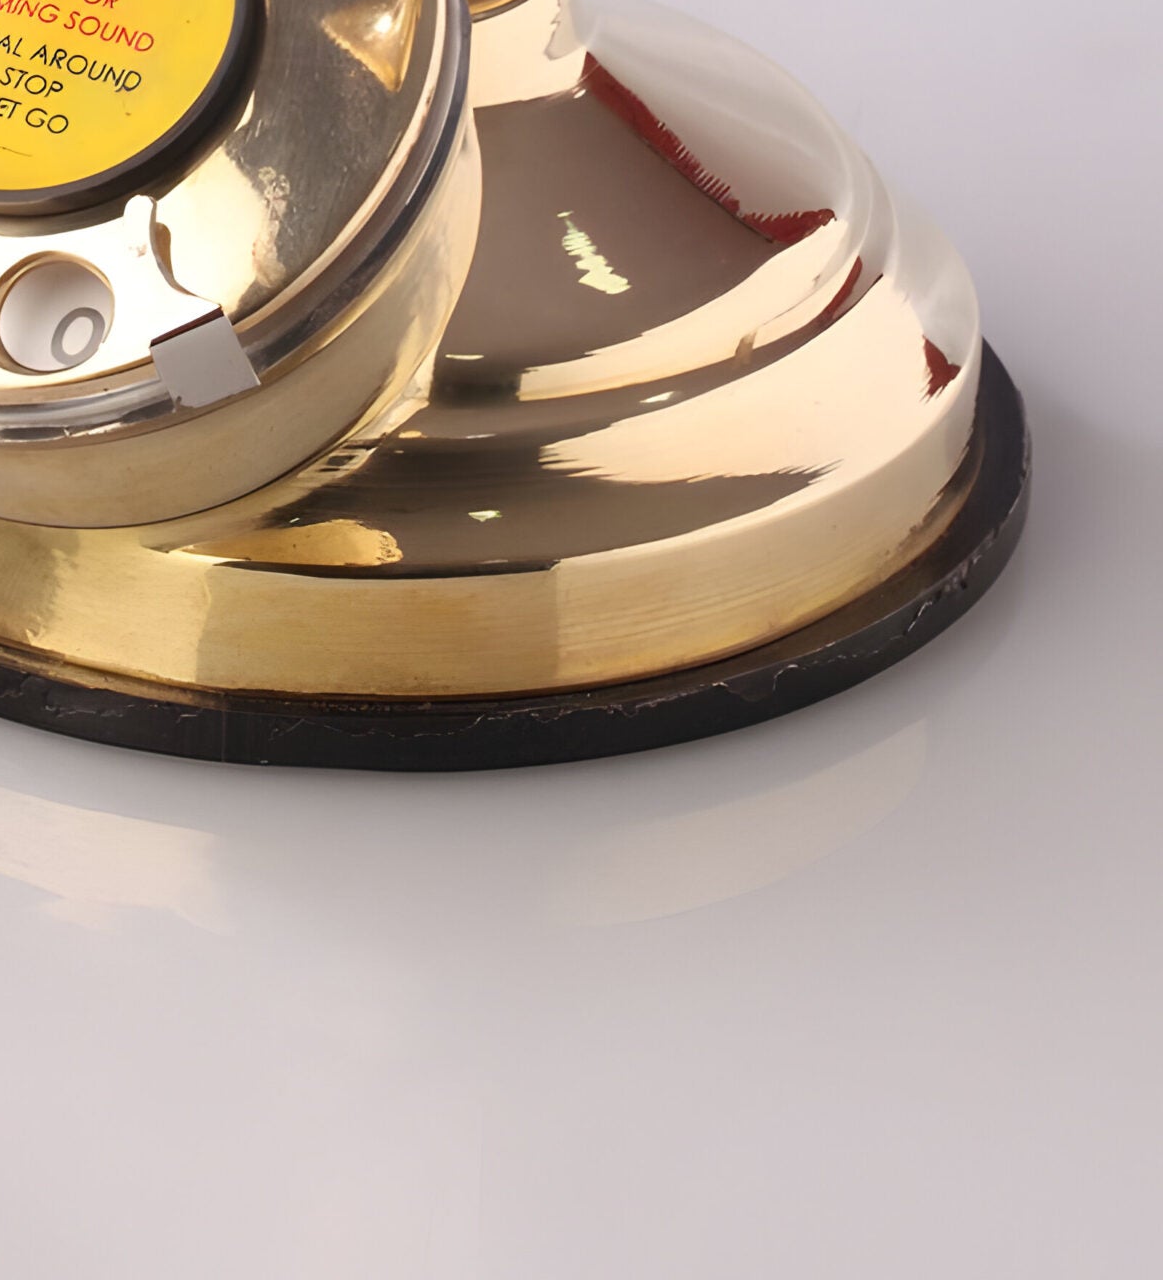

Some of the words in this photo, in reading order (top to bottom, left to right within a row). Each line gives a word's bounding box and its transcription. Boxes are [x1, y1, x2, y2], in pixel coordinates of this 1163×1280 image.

[63, 10, 156, 54] SOUND
[29, 43, 143, 94] AROUND
[25, 108, 70, 135] GO
